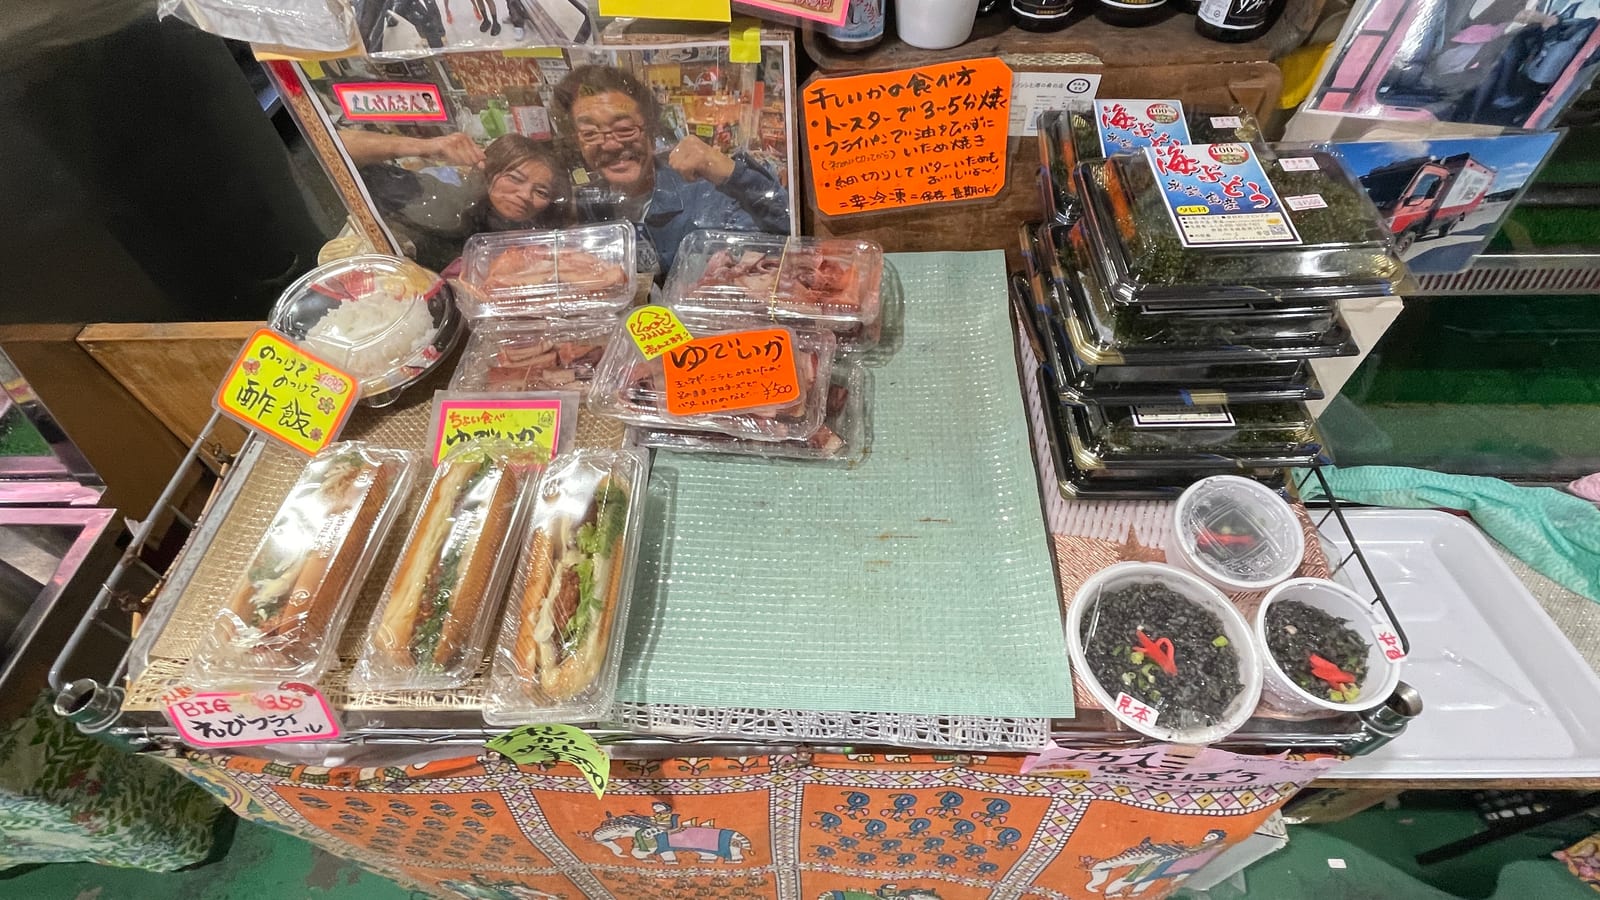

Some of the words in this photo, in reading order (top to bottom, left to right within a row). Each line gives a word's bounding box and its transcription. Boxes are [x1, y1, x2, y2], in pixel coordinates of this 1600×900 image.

[808, 66, 976, 110] 干しいかの食べ方
[1155, 141, 1271, 210] 海ぶどう
[259, 345, 308, 378] のっけて
[670, 335, 785, 372] ゆでいか
[273, 375, 321, 399] のっけて
[177, 699, 232, 717] BIG
[1117, 695, 1151, 722] 見本
[188, 714, 298, 738] えびフライ
[274, 724, 323, 736] ロール
